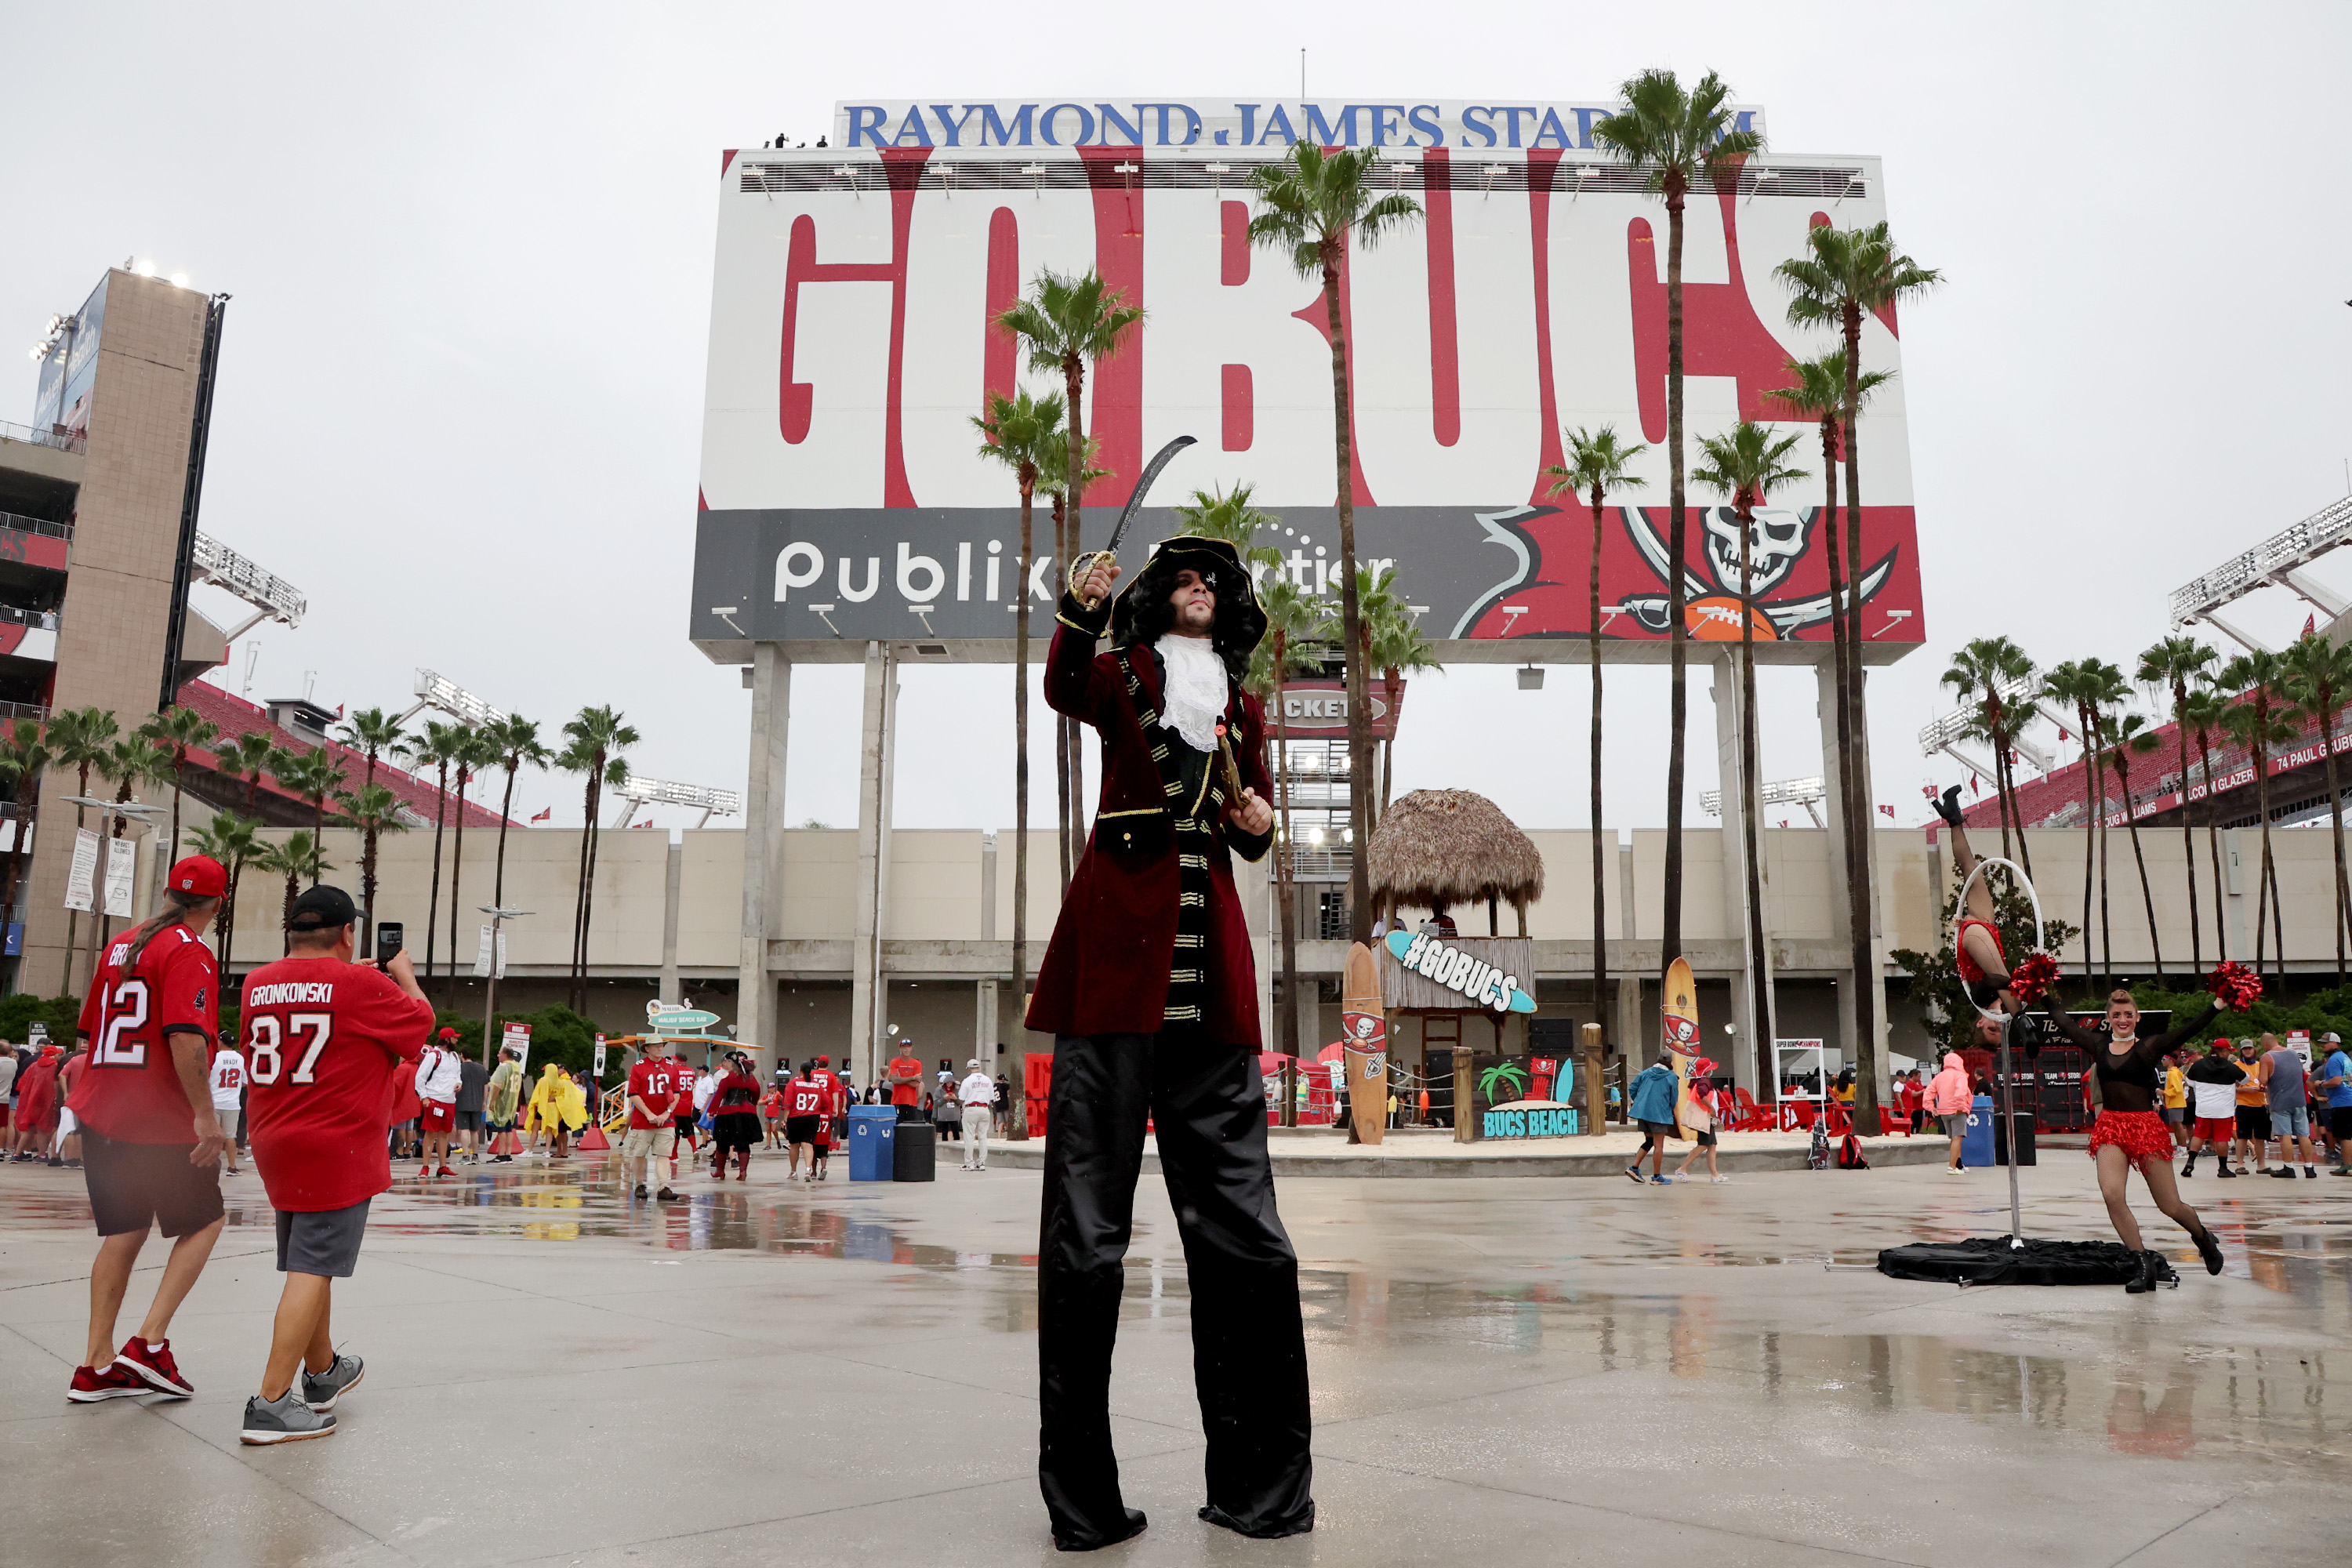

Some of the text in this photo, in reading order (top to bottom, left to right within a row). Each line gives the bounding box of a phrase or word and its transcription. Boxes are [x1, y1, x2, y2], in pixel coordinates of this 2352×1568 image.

[844, 103, 1201, 147] RAYMOND
[1214, 103, 1444, 148] JAMES
[775, 539, 1052, 603] Publix
[2218, 768, 2254, 790] GLAZER
[2277, 756, 2288, 771] 74
[2290, 748, 2317, 767] PAUL
[1403, 931, 1518, 1012] #GOBUCS
[250, 982, 333, 1007] GRONKOWSKI
[91, 978, 151, 1069] 12
[249, 1011, 334, 1087] 87
[781, 1060, 786, 1069] 2
[813, 1059, 818, 1069] 3
[845, 1059, 851, 1069] 4
[944, 1061, 949, 1070] 7
[219, 1068, 240, 1088] 12
[648, 1073, 670, 1095] 12
[679, 1076, 694, 1091] 95
[796, 1093, 818, 1111] 87
[1483, 1109, 1578, 1137] BUCS BEACH
